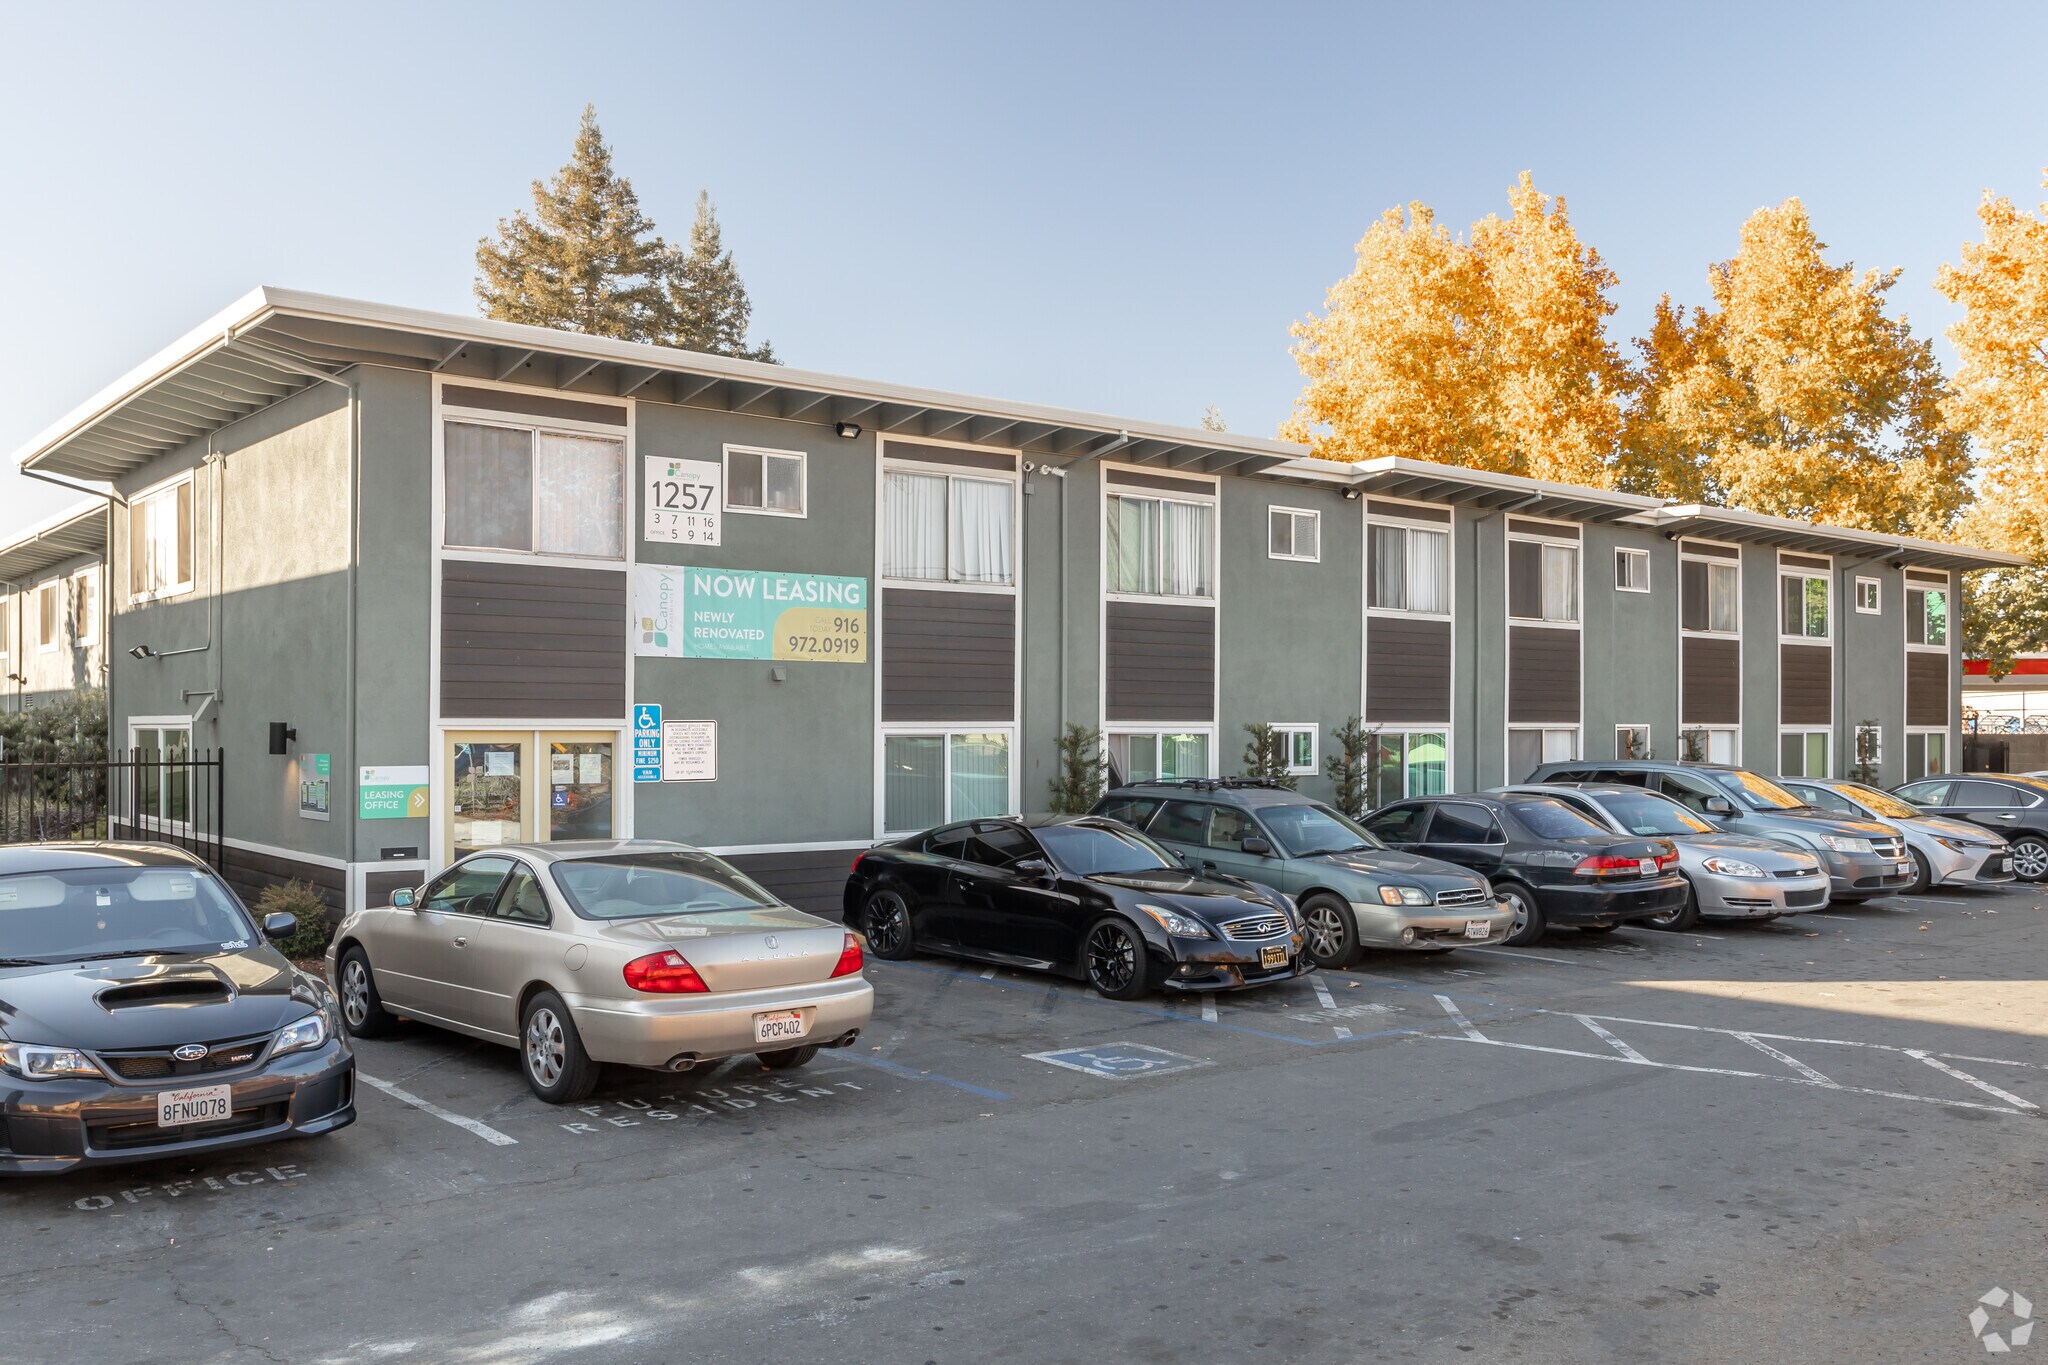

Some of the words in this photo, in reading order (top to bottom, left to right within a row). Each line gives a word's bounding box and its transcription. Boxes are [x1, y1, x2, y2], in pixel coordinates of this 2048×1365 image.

[675, 469, 701, 481] Canopy
[652, 480, 715, 511] 1257
[654, 513, 661, 524] 3
[671, 514, 678, 525] 7
[687, 516, 695, 526] 11
[703, 517, 714, 528] 16
[671, 528, 678, 539] 5
[687, 530, 695, 540] 9
[703, 531, 714, 541] 14
[694, 573, 756, 599] NOW
[763, 578, 860, 604] LEASING
[654, 573, 674, 632] Canopy
[694, 611, 735, 623] NEWLY
[833, 616, 860, 634] 916
[694, 627, 765, 640] RENOVATED
[788, 635, 860, 654] 972.0919
[634, 728, 660, 738] PARKING
[638, 738, 656, 748] ONLY
[364, 790, 404, 799] LEASING
[364, 800, 399, 809] OFFICE
[742, 950, 809, 962] ACURA
[761, 1020, 802, 1038] 6PCP402
[231, 1053, 254, 1062] WRX
[173, 1090, 218, 1102] California
[577, 1077, 804, 1117] FUURE
[163, 1098, 227, 1121] 8FNU078
[558, 1081, 864, 1135] RESIDENT
[74, 1164, 308, 1211] OFFICE
